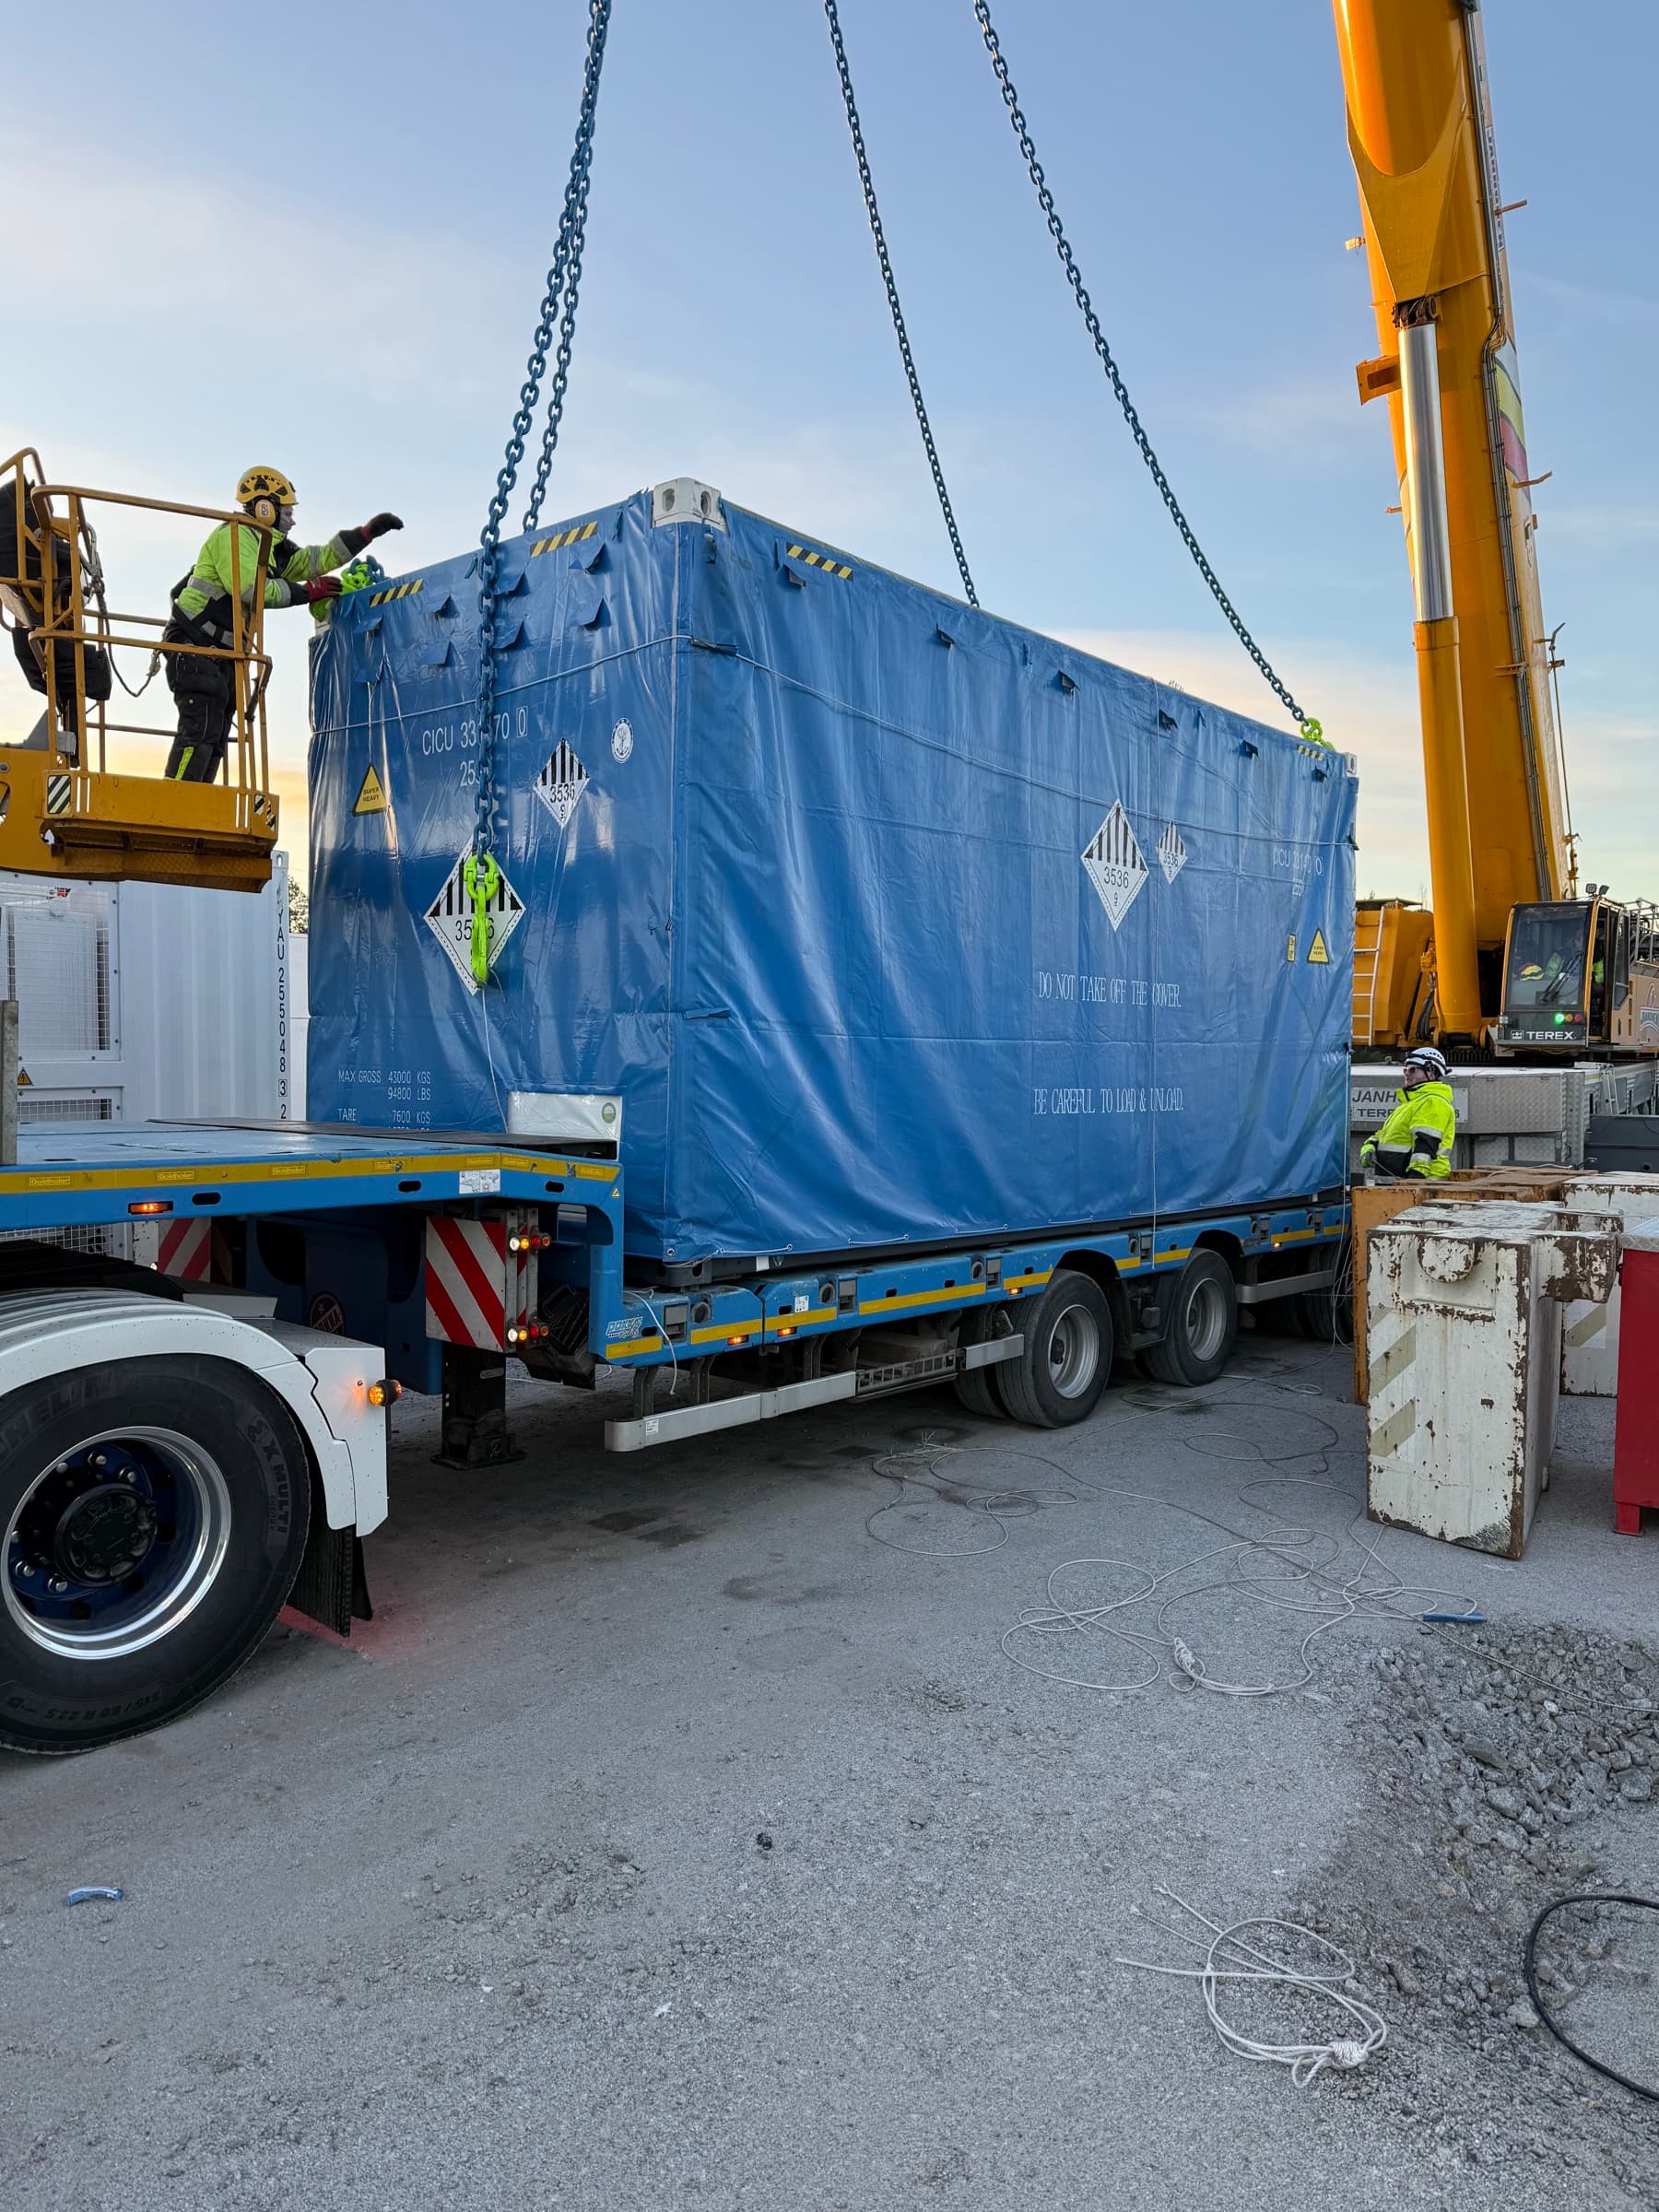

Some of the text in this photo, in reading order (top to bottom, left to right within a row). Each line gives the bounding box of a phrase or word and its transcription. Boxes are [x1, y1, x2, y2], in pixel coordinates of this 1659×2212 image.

[422, 724, 453, 755] CICU
[461, 712, 510, 748] 3370
[362, 794, 380, 803] HEAVY
[549, 782, 576, 804] 3536
[1162, 850, 1179, 867] 3536
[1103, 866, 1129, 889] 3536
[276, 888, 287, 960] YAU
[454, 918, 495, 942] 356
[1039, 971, 1053, 999] DO
[1055, 973, 1076, 1000] NOT
[1080, 975, 1107, 1003] TAKE
[1110, 978, 1126, 1004] OFF
[1131, 980, 1147, 1006] THE
[277, 968, 287, 1074] 255048
[1525, 1030, 1575, 1041] TEREX
[338, 1070, 431, 1085] MAX GROSS 43000 KGS
[387, 1087, 431, 1100] 94800 LBS
[1033, 1088, 1048, 1114] BE
[1051, 1088, 1095, 1114] CAREFUL
[1100, 1088, 1113, 1112] TO
[1116, 1088, 1136, 1112] LOAD
[337, 1108, 431, 1124] TARE 7600 KGS
[272, 1464, 288, 1533] MULTI
